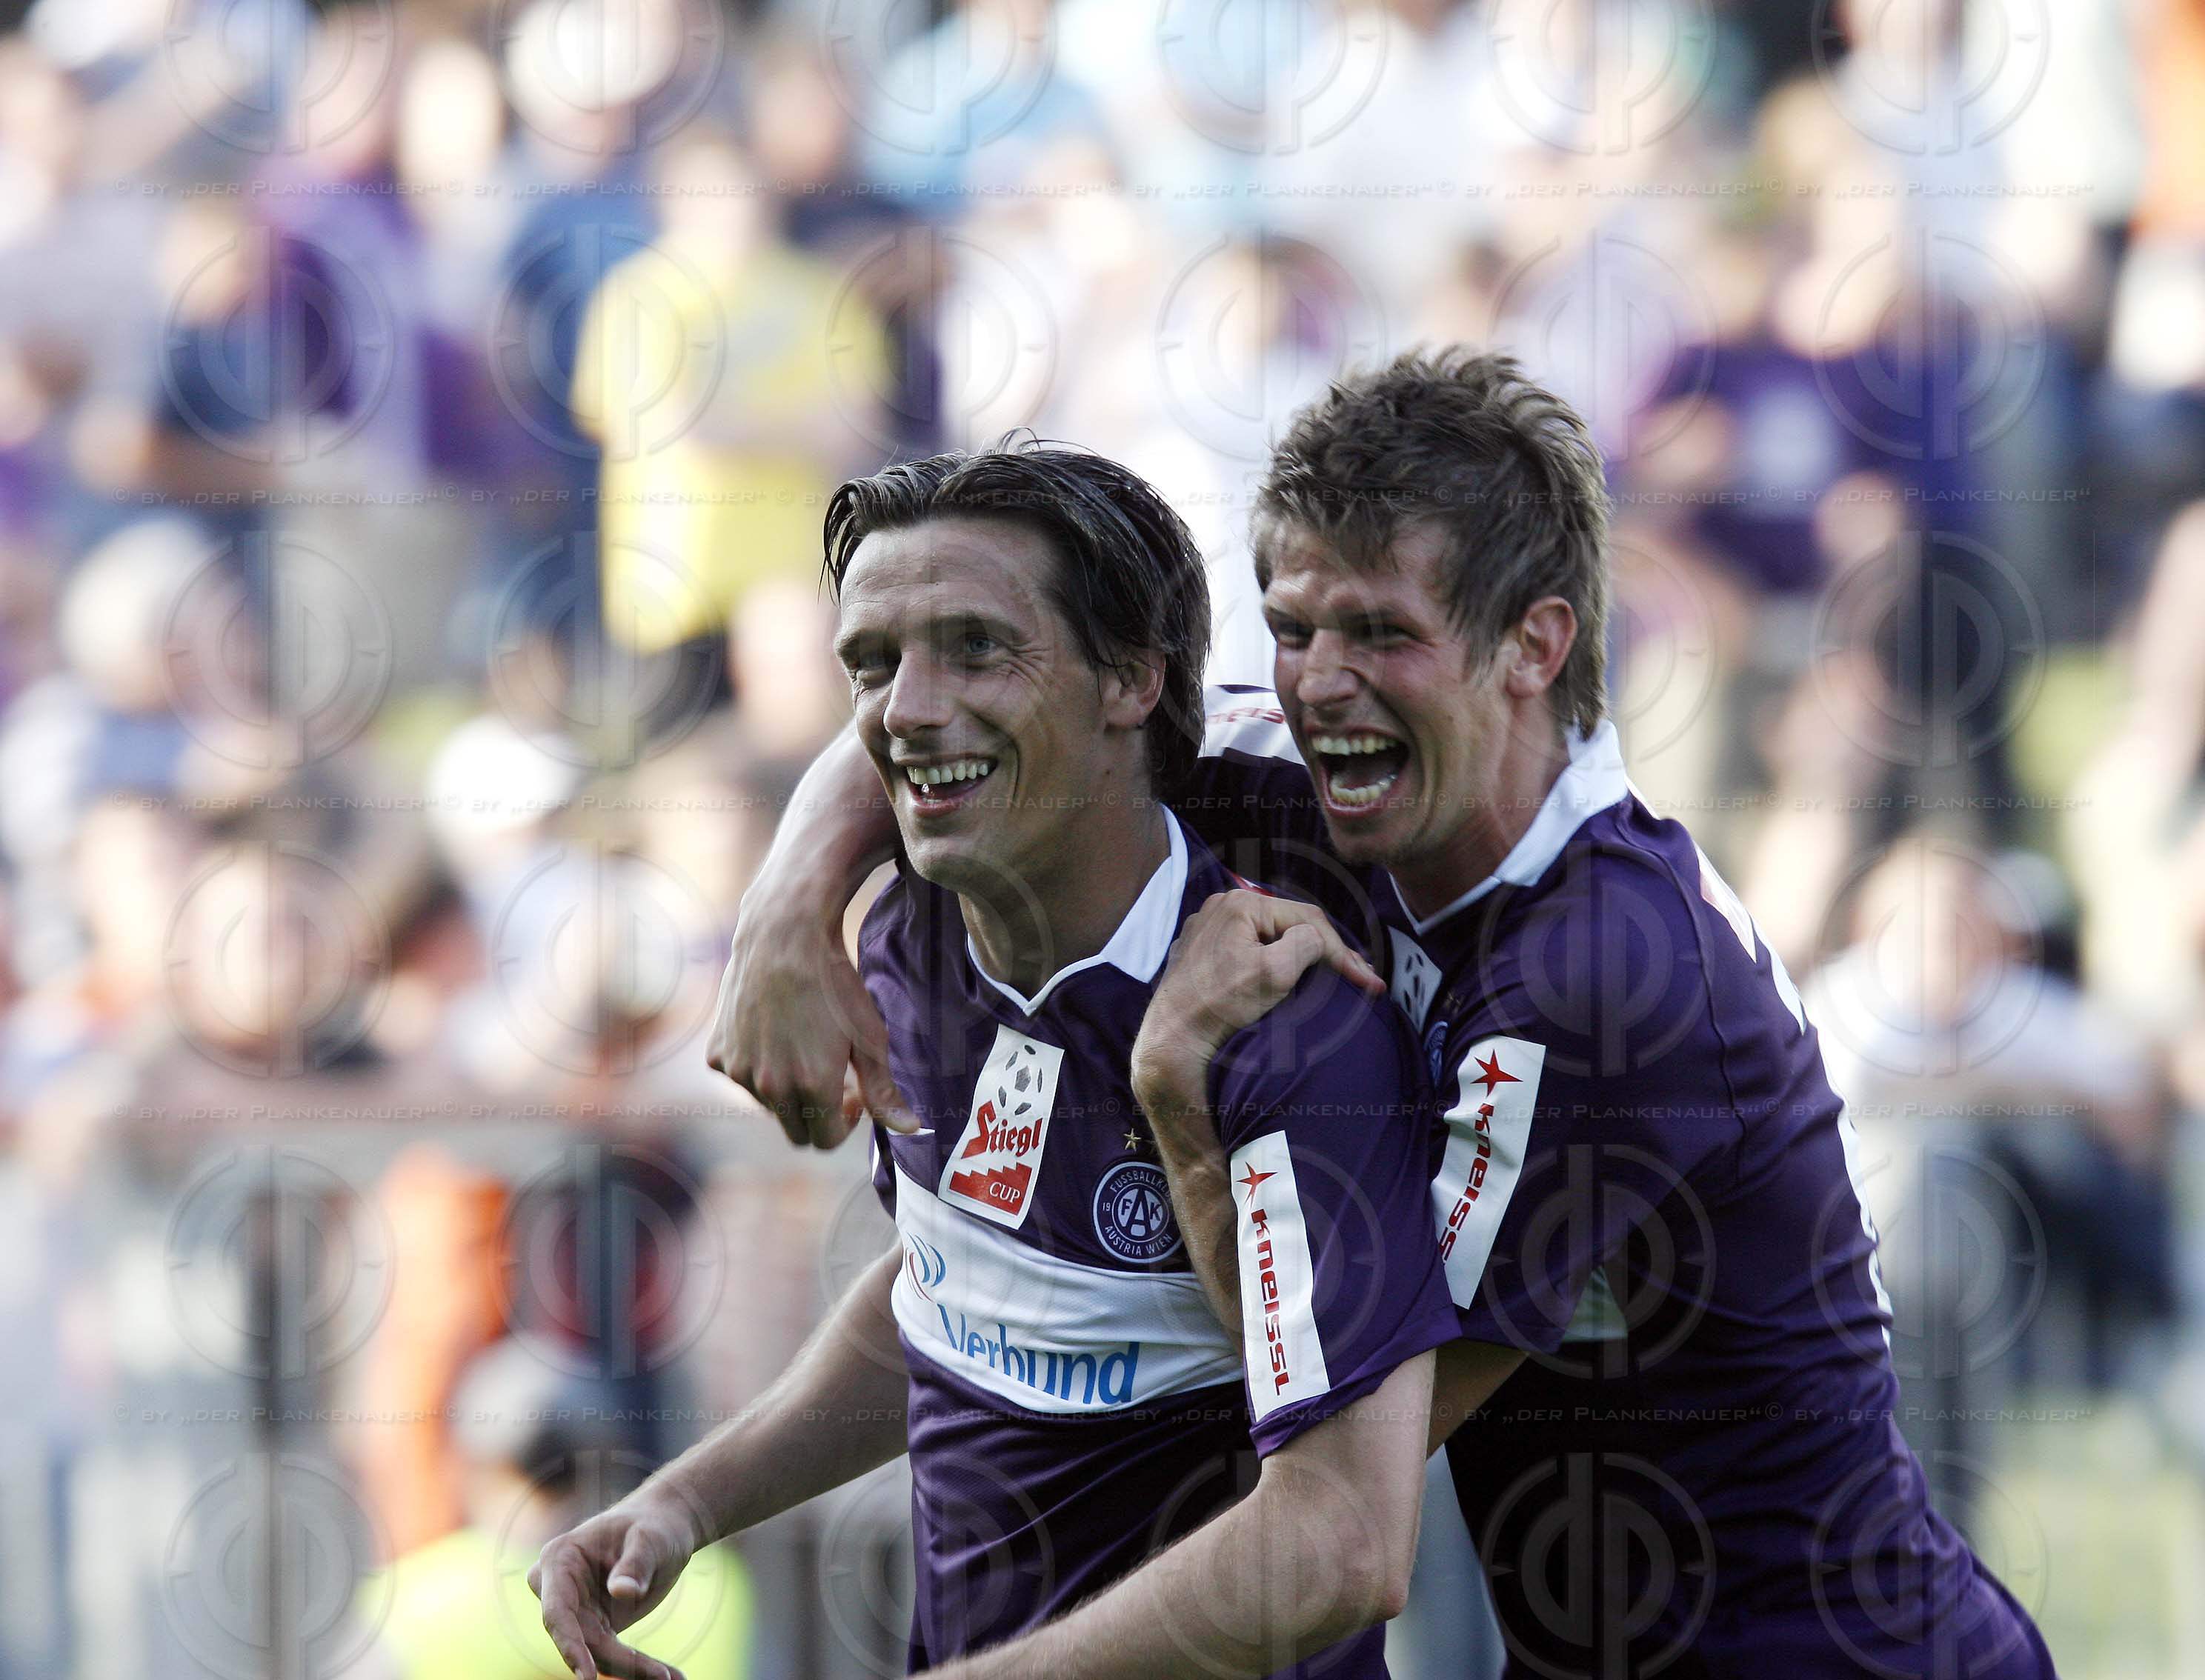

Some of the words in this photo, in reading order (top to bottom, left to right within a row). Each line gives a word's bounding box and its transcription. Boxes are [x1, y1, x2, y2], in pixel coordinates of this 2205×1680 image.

[961, 1100, 1043, 1159] Stiegl
[989, 1181, 1021, 1204] CUP
[1102, 1202, 1111, 1211] 19
[1105, 1226, 1142, 1256] AUSTRIA
[1146, 1233, 1173, 1255] WIEN
[937, 1303, 1140, 1404] Verbund
